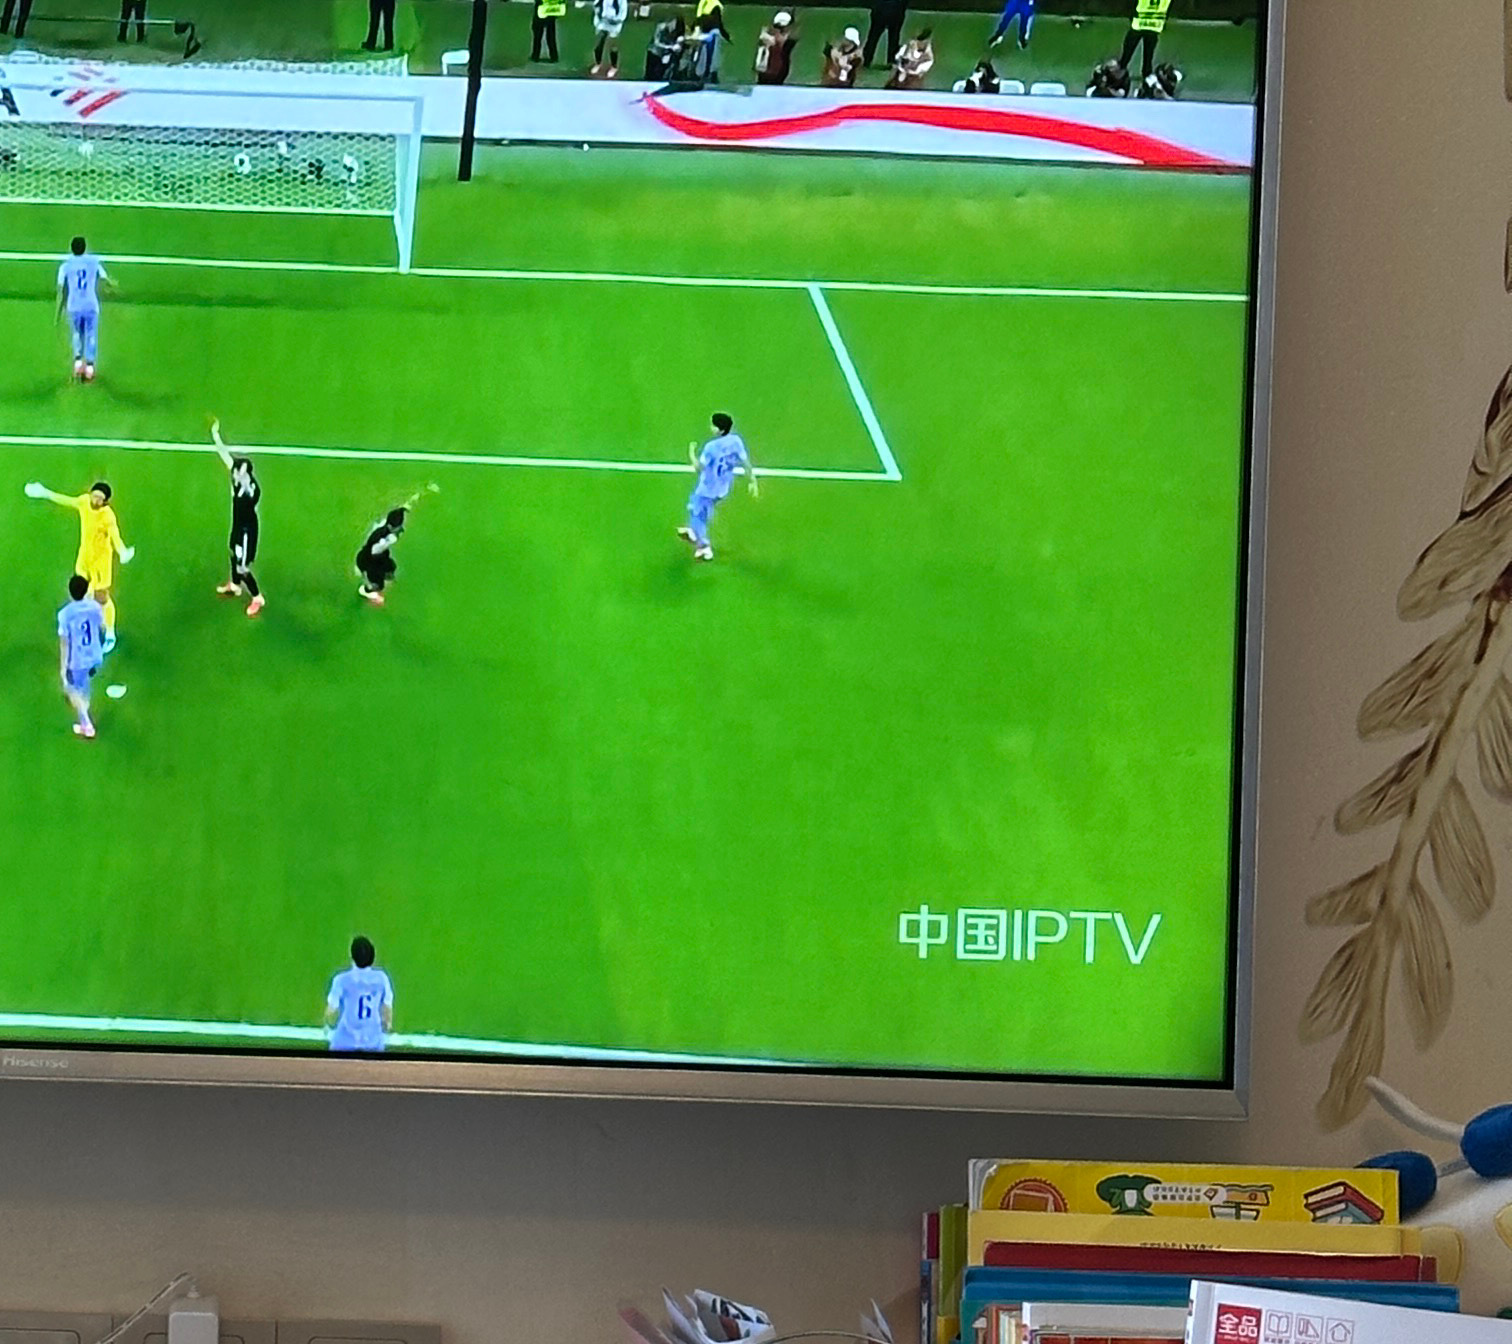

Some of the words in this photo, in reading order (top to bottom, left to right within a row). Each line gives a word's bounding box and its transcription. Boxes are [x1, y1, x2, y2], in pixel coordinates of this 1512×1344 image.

[898, 903, 1163, 965] 中国IPTV
[358, 994, 373, 1020] 6
[2, 1054, 70, 1069] Hisense
[1217, 1312, 1259, 1338] 全品
